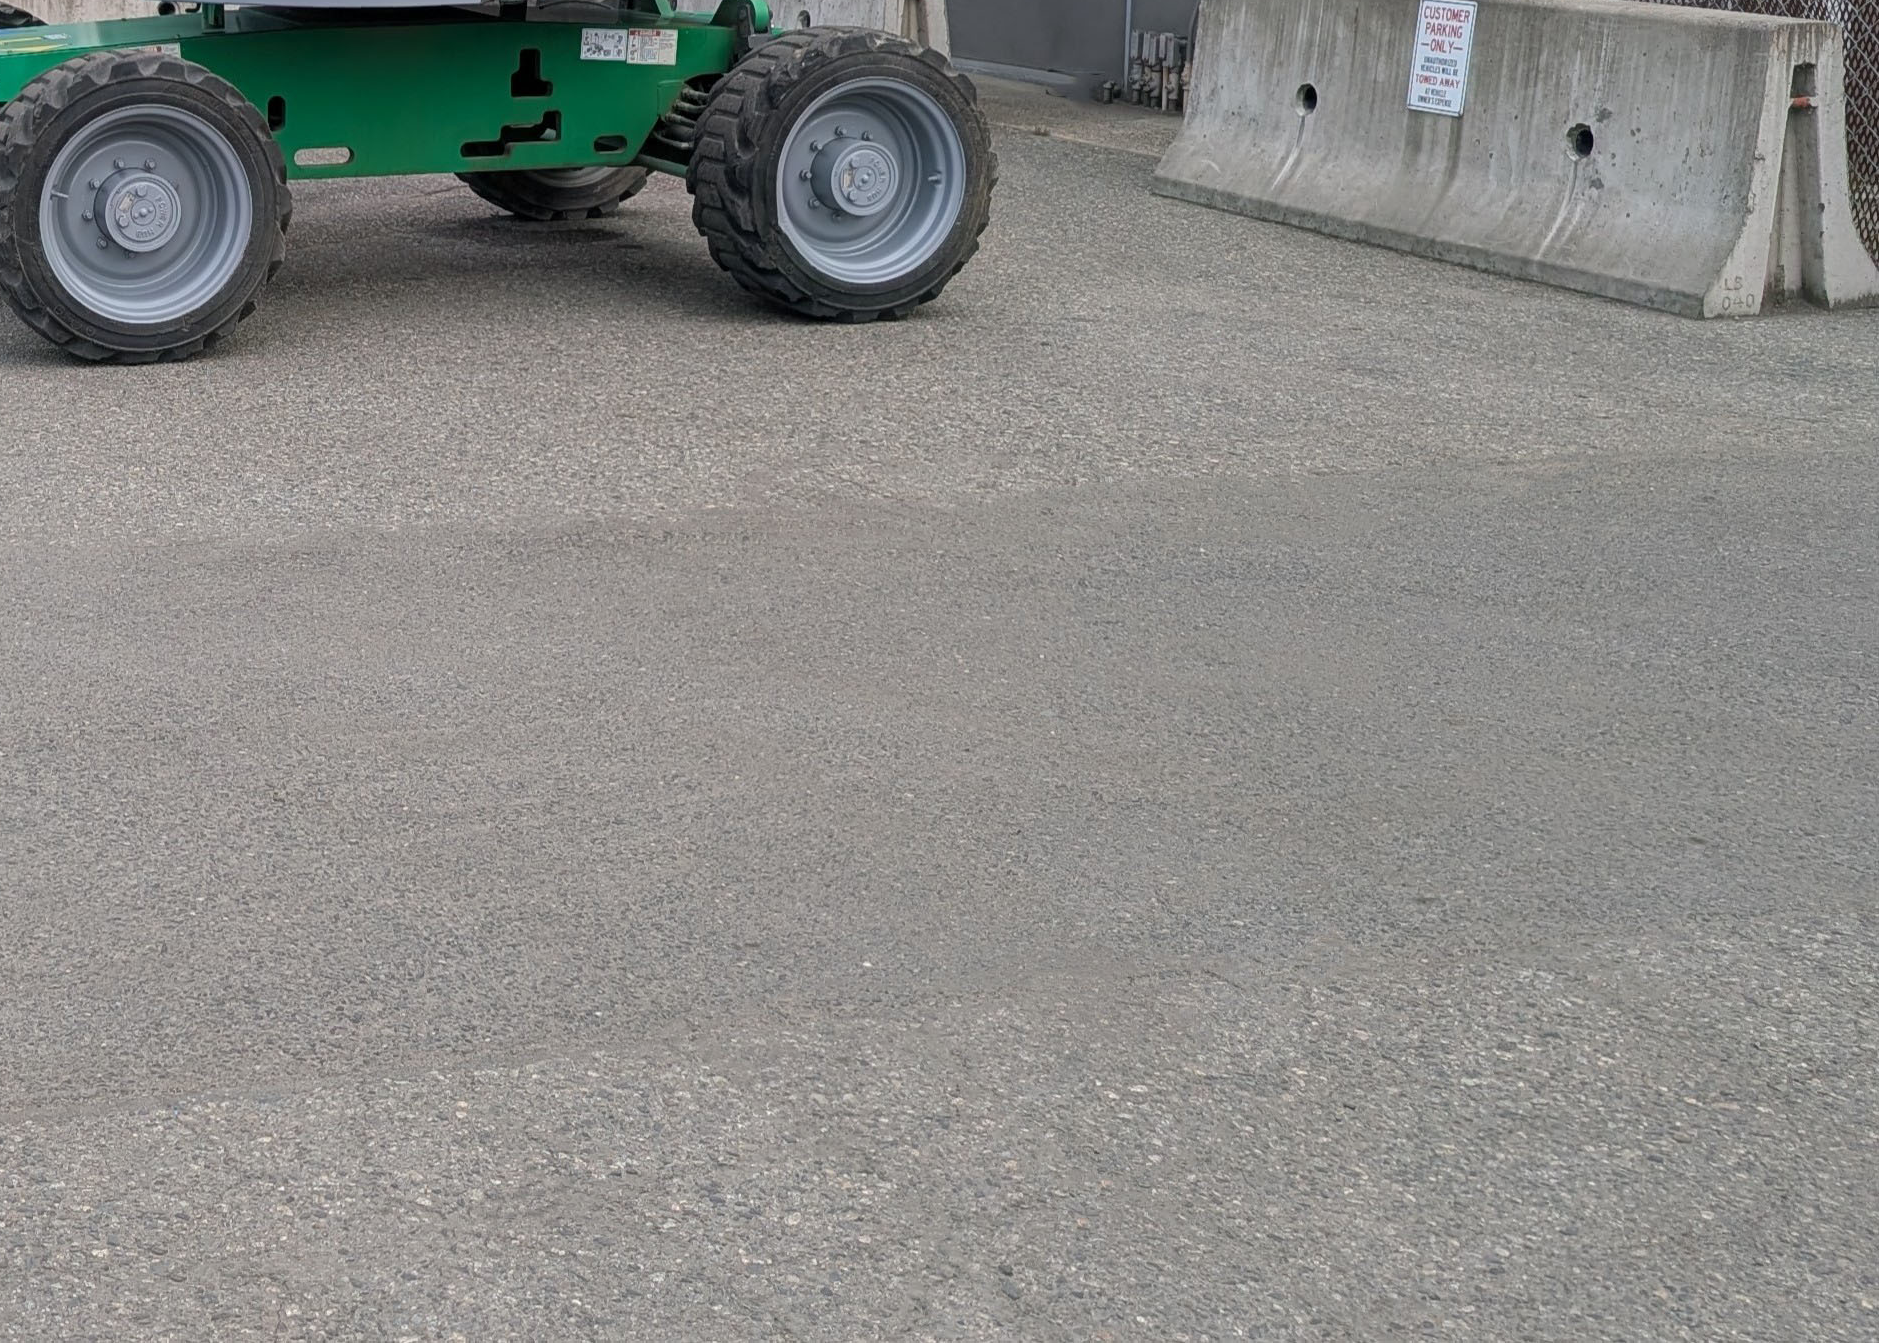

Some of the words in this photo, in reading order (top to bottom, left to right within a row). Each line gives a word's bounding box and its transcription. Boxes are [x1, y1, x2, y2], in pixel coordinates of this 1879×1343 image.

[1423, 5, 1471, 24] CUSTOMER
[1425, 21, 1463, 39] PARKING
[1415, 73, 1438, 86] TOWED
[1439, 77, 1461, 90] AWAY
